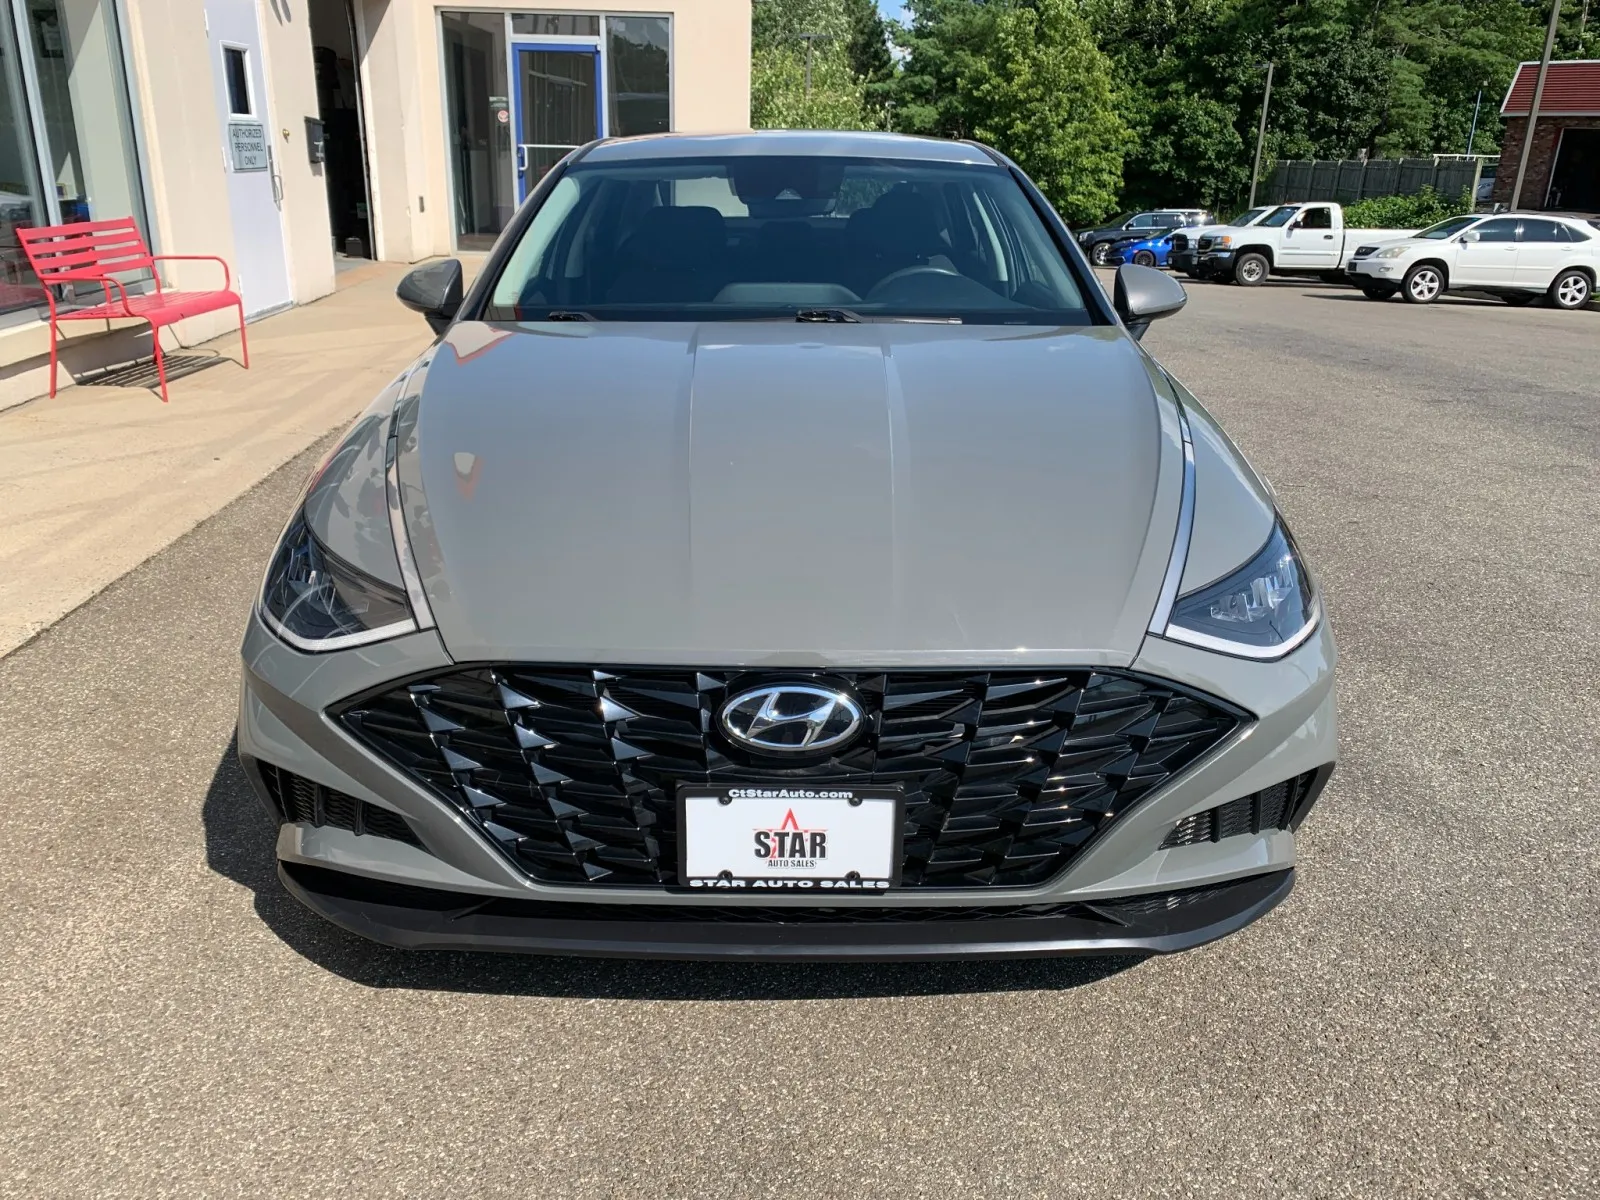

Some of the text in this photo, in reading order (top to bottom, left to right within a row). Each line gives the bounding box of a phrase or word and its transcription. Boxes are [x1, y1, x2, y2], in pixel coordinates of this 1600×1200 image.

[232, 128, 262, 138] AUTHORIZED
[235, 142, 263, 152] PERSONNEL
[244, 155, 257, 166] ONLY
[728, 788, 853, 799] CtStarAuto.com
[754, 830, 827, 859] STAR
[767, 859, 815, 868] AUTO SALES
[689, 879, 890, 889] STAR AUTO SALES
